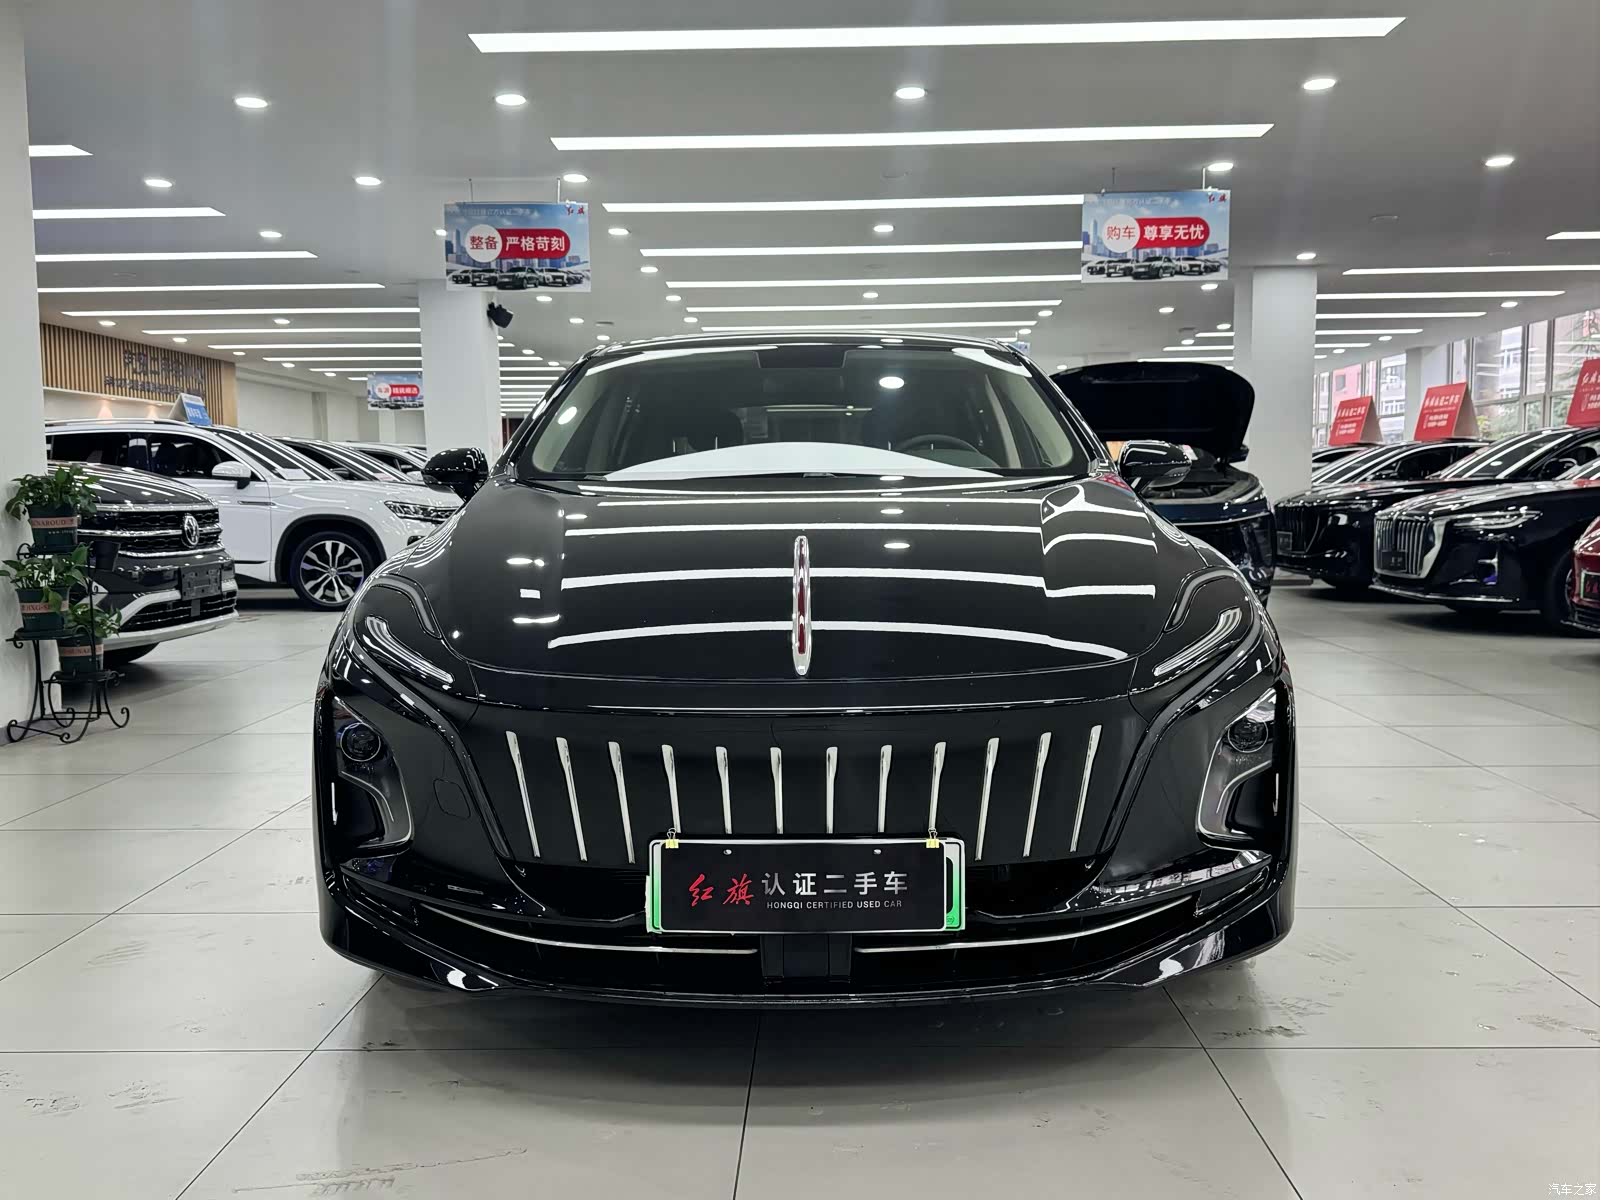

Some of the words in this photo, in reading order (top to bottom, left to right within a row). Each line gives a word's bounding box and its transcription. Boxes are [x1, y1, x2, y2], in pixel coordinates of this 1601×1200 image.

[1106, 225, 1136, 240] 购车
[1143, 224, 1205, 241] 尊享无忧
[469, 235, 498, 250] 整备
[505, 235, 566, 251] 严格苛刻
[689, 873, 754, 907] 红旗
[761, 871, 908, 896] 认证二手车
[766, 901, 803, 909] HONGQI
[806, 901, 854, 909] CERTIFIED
[856, 900, 881, 909] USED
[883, 900, 903, 908] CAR
